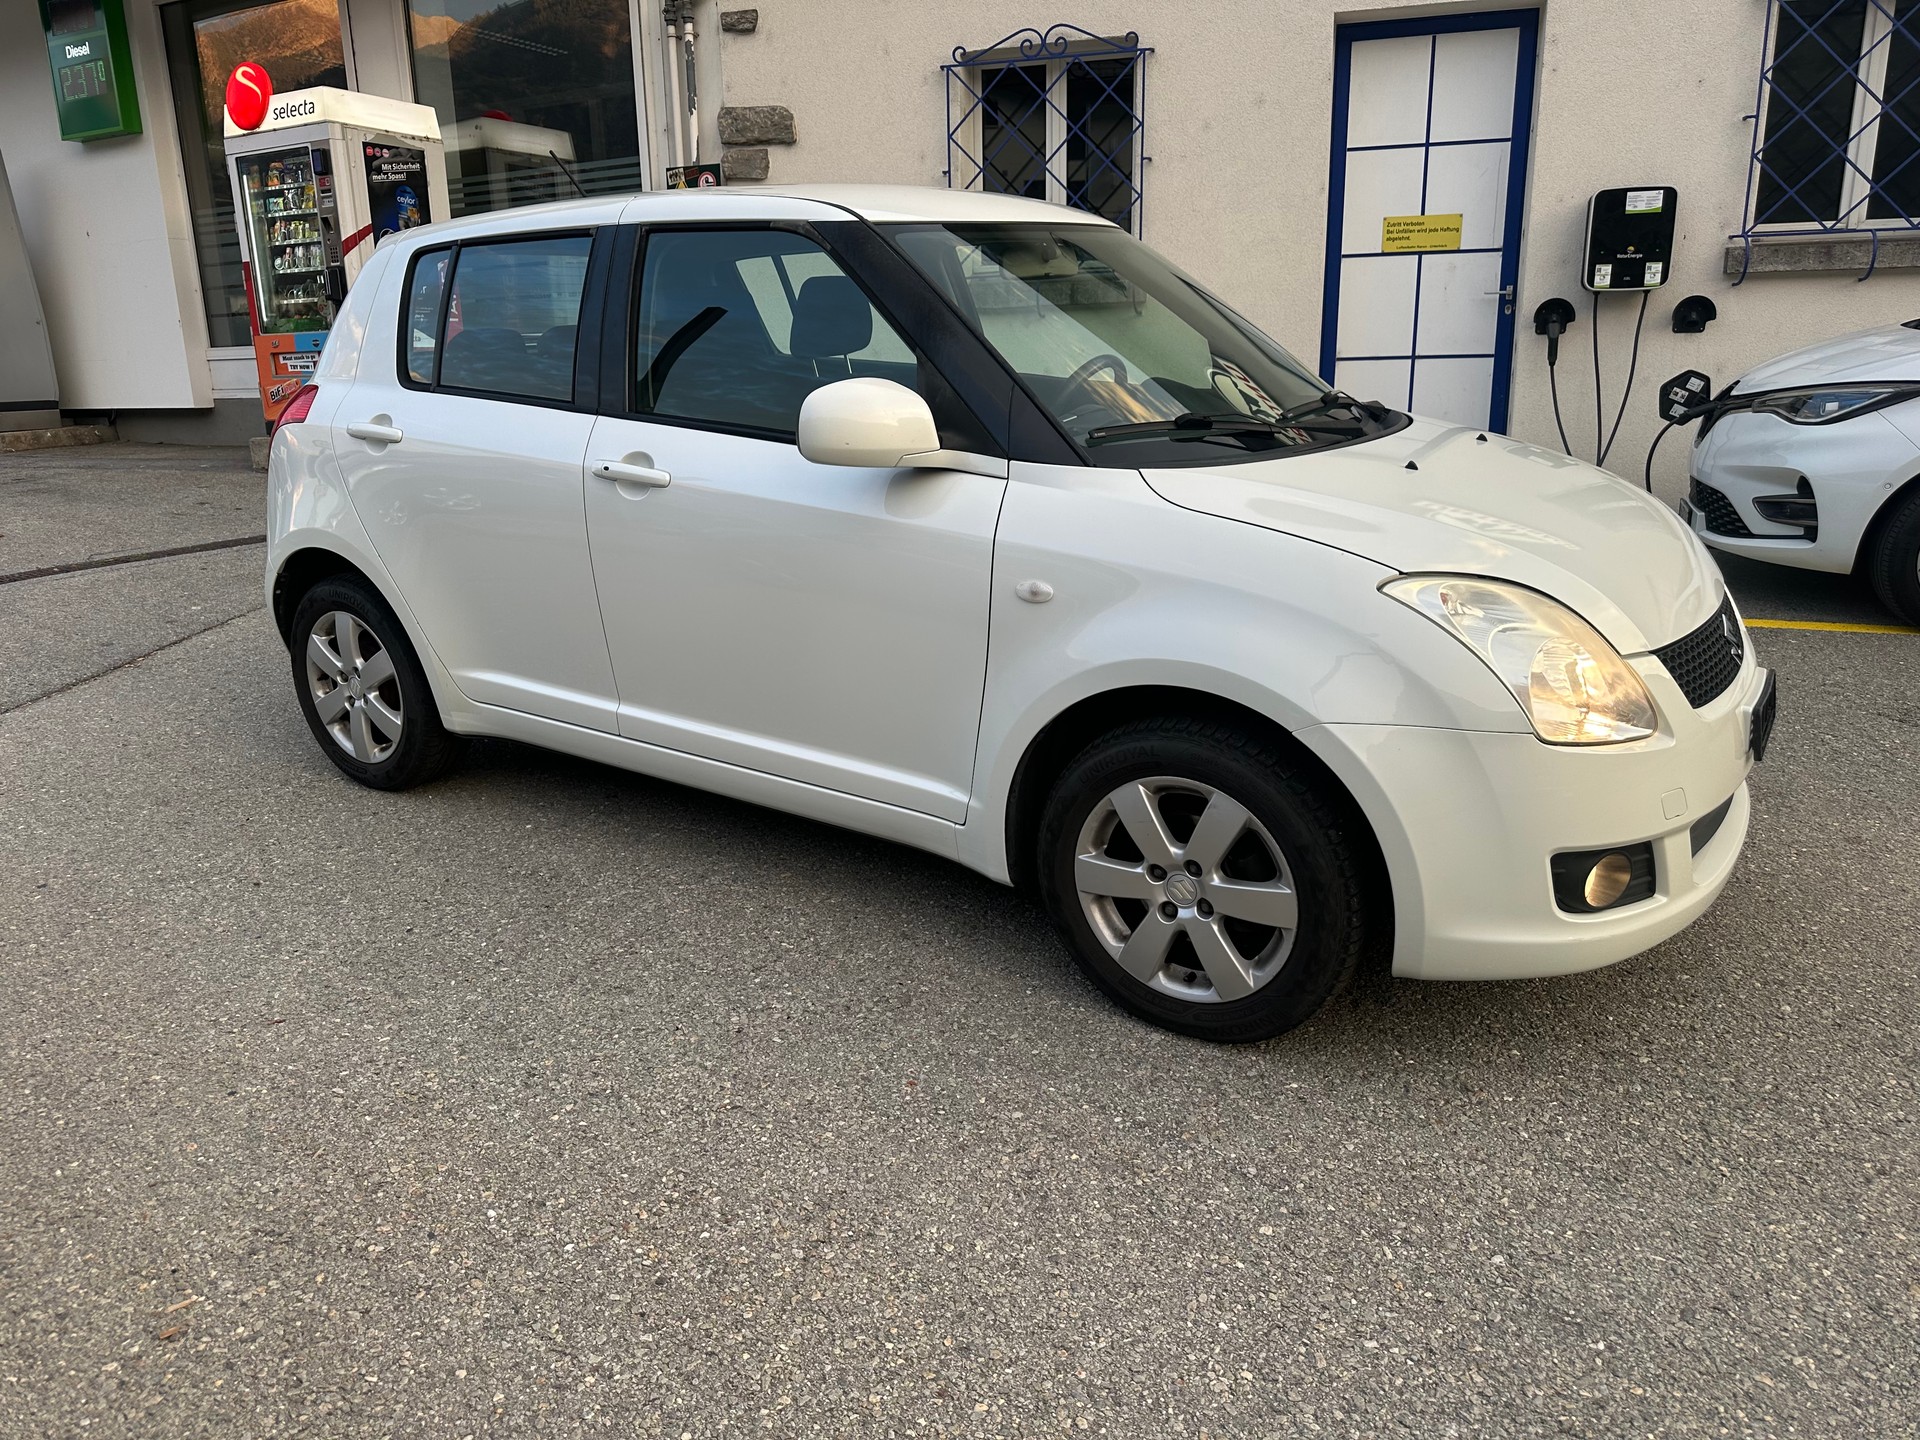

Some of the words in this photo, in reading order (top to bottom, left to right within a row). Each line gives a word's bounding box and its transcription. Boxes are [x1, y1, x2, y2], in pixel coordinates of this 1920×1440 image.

[65, 41, 90, 58] Diesel
[273, 99, 315, 120] selecta
[392, 162, 420, 170] Sicherheit
[372, 173, 387, 181] mehr
[388, 172, 406, 180] Spass!
[396, 196, 416, 205] ceylor
[269, 384, 285, 402] BiFi
[328, 588, 370, 617] UNIROYAL
[1078, 744, 1161, 784] UNIROYAL
